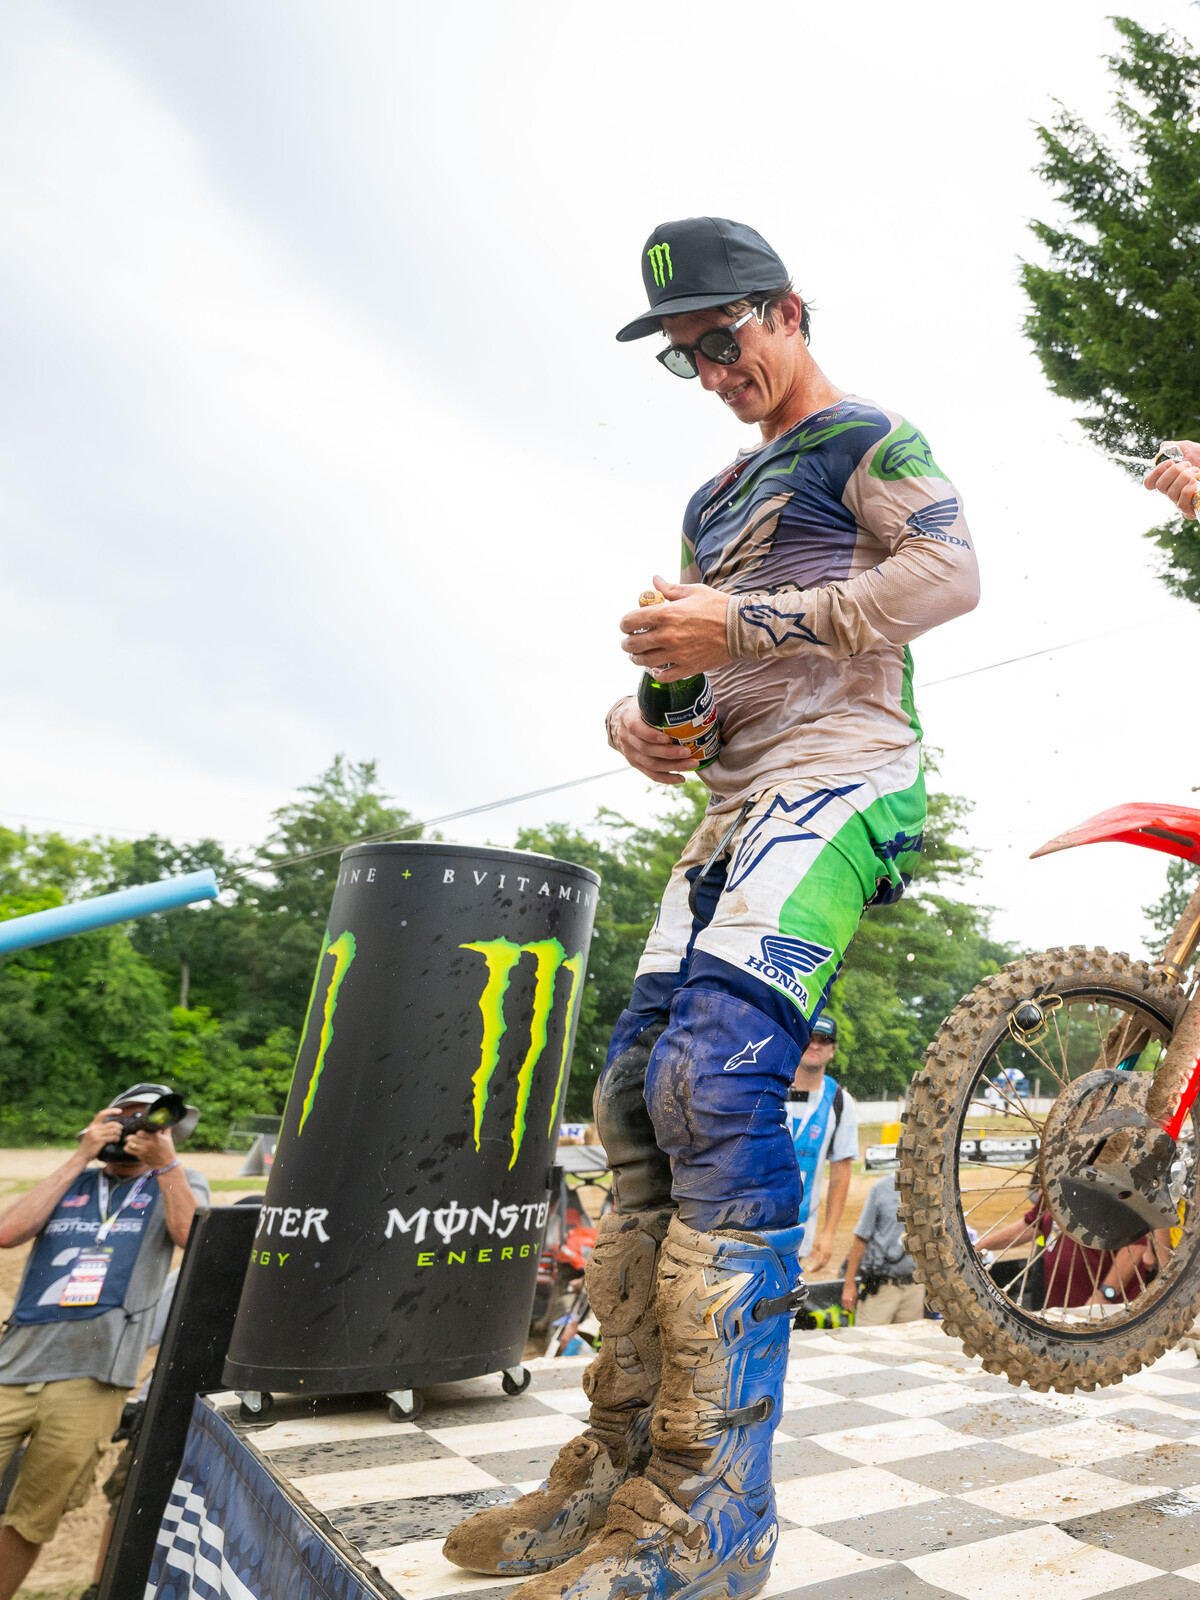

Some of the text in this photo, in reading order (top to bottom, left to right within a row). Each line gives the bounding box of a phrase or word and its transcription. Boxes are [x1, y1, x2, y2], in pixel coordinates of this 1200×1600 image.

[744, 955, 808, 1008] HONDA
[45, 1220, 143, 1234] MOTOCOSS
[416, 1243, 541, 1267] ENERGY
